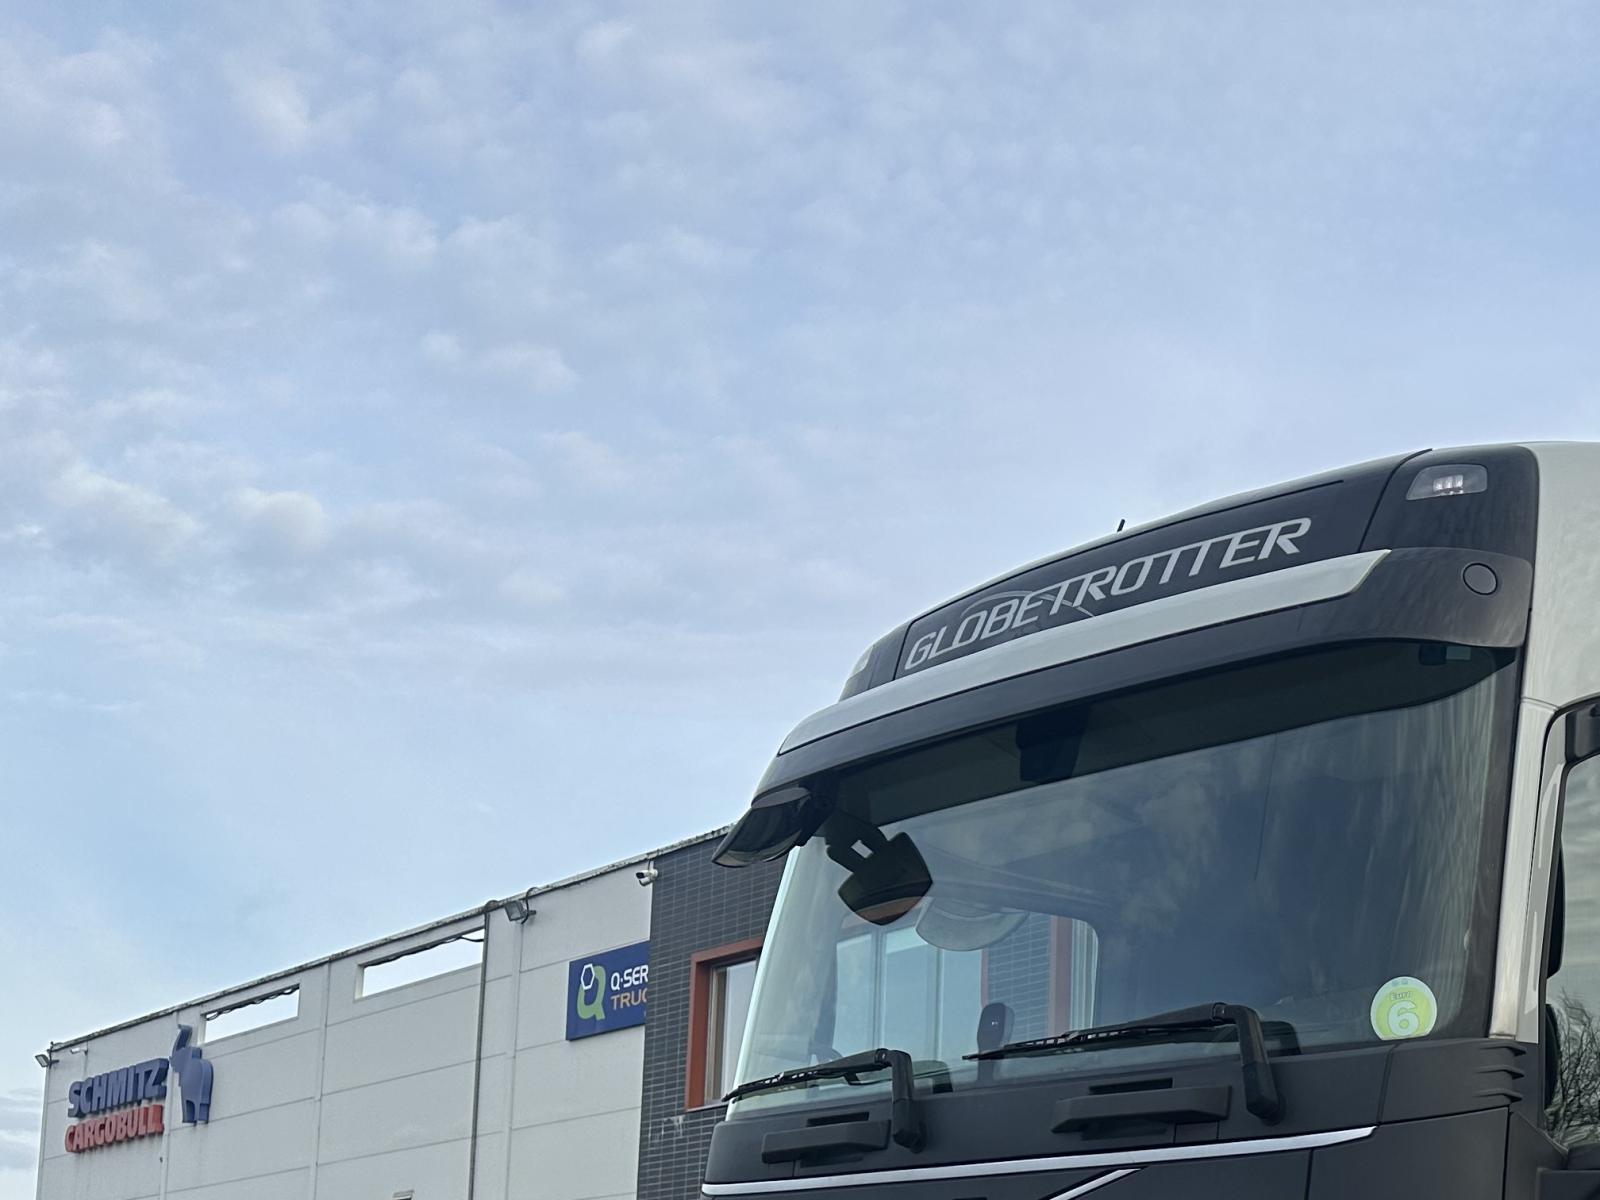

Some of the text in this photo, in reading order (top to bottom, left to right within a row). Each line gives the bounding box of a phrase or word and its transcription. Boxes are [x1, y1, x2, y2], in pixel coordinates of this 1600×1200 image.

[904, 516, 1313, 671] GLOBETROTTER
[1388, 1000, 1419, 1036] 6
[68, 1057, 169, 1118] SCHMITZ
[65, 1104, 164, 1153] CARGOBULL
